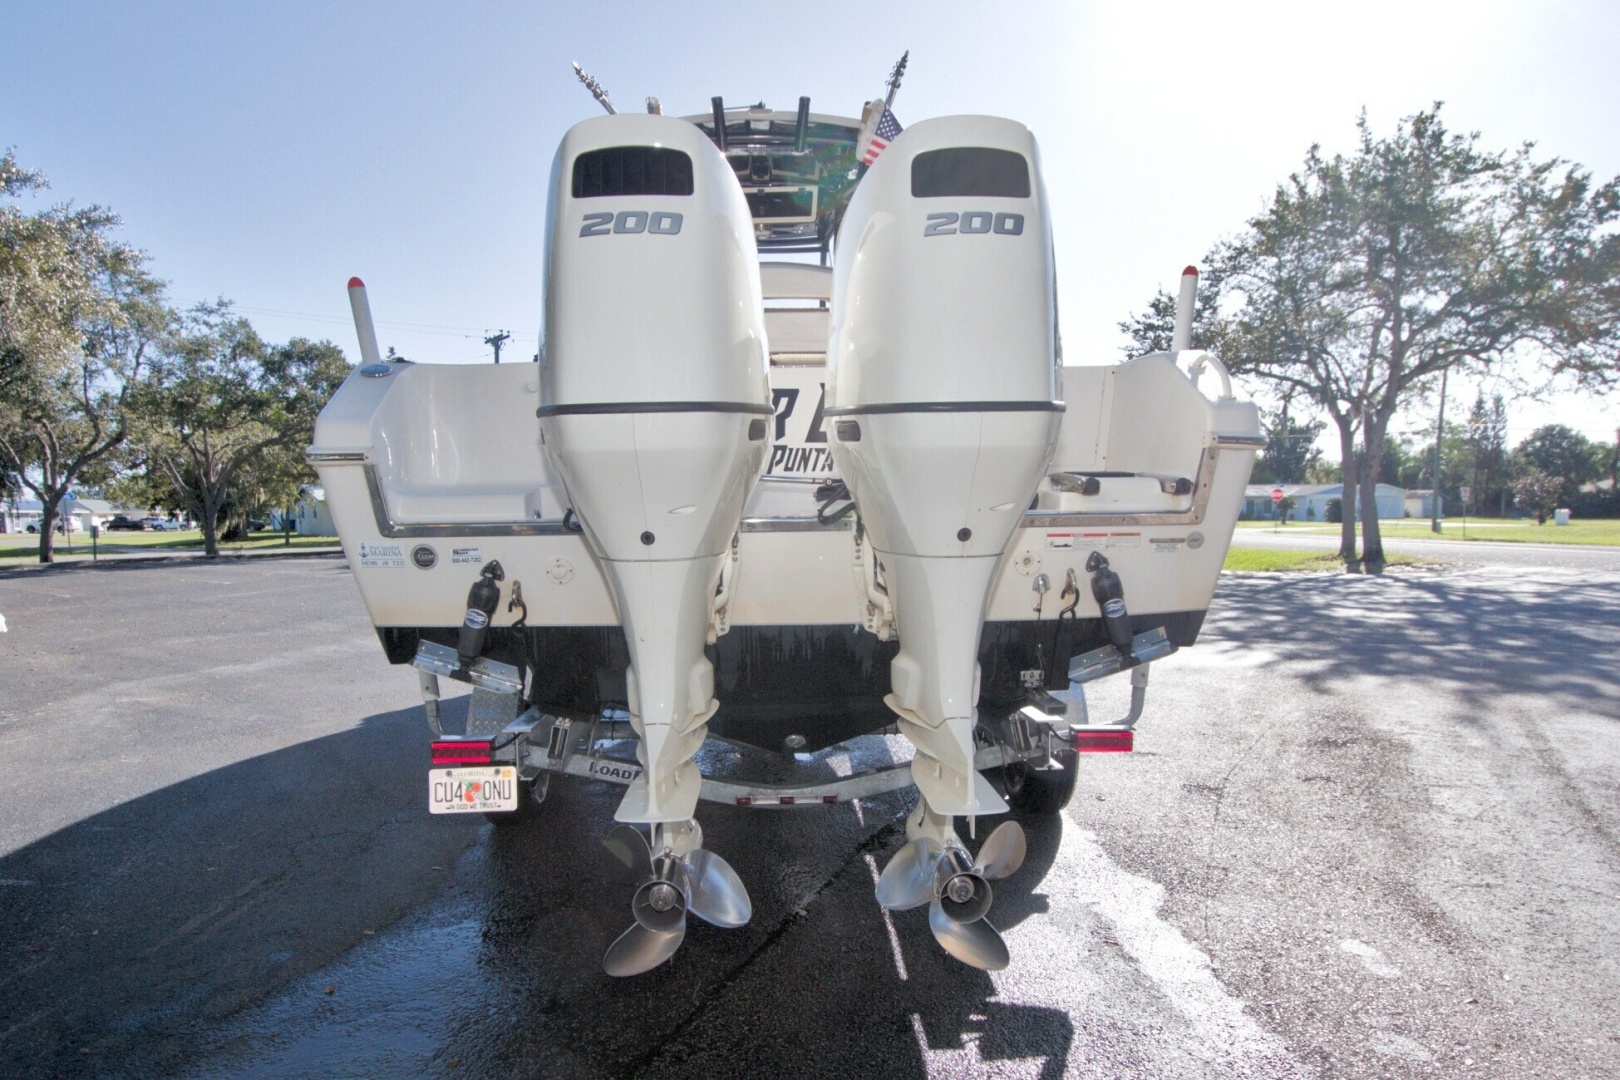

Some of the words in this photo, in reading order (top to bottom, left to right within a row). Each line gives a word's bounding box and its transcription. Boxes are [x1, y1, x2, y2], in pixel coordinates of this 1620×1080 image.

[579, 211, 684, 238] 200
[924, 211, 1024, 237] 200
[766, 445, 834, 475] PUNTA
[434, 781, 463, 803] CU4
